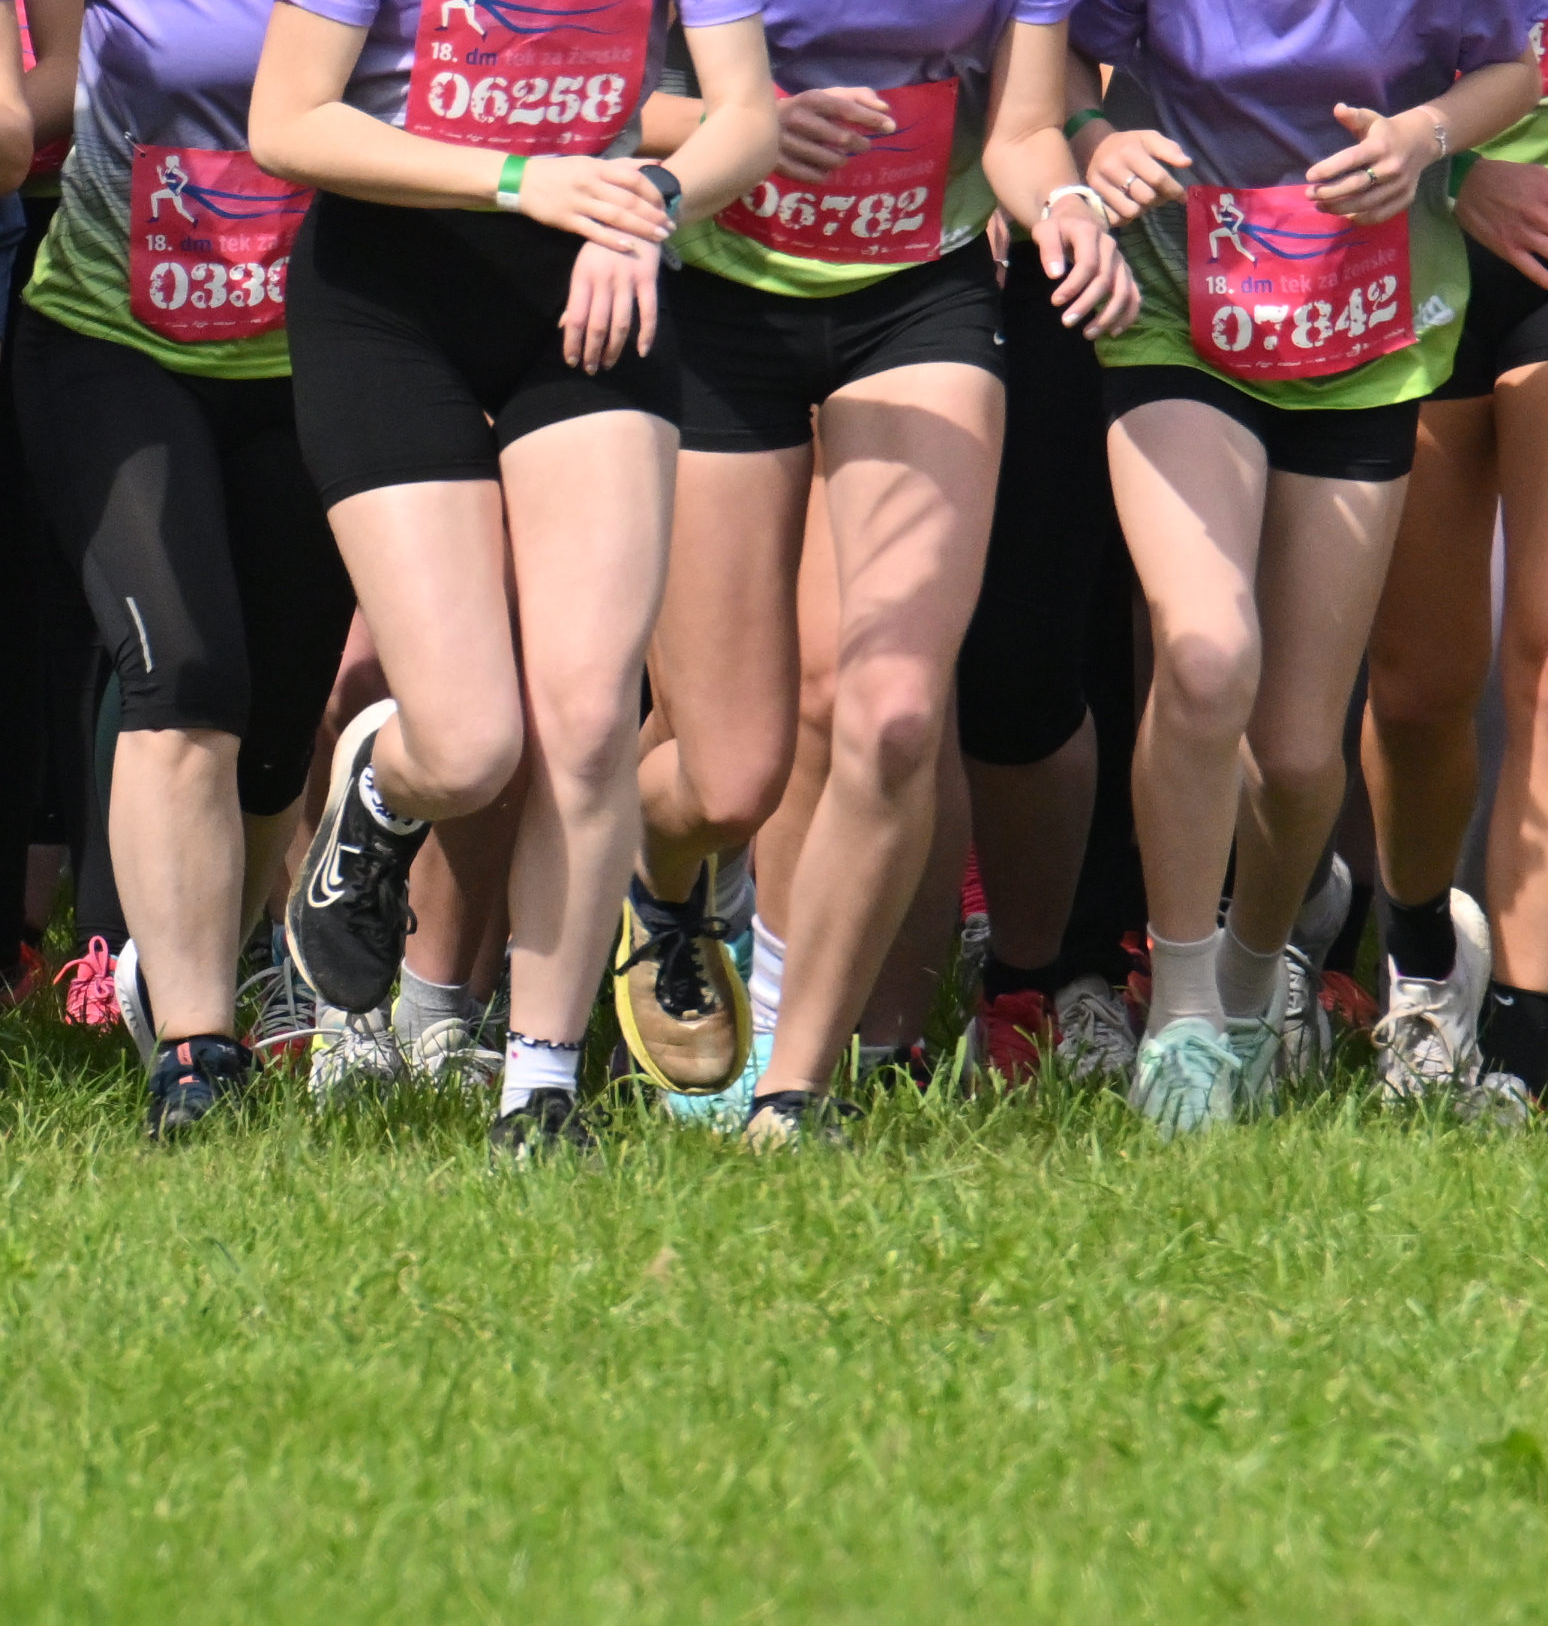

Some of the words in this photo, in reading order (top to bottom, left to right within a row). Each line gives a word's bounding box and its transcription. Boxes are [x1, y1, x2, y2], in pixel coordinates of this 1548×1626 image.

[431, 41, 458, 63] 18.
[466, 48, 497, 66] dm
[428, 72, 626, 125] 06258
[741, 181, 928, 238] 06782
[145, 234, 173, 251] 18.
[181, 235, 212, 252] dm
[219, 234, 251, 252] tek
[257, 236, 279, 251] za
[150, 256, 291, 310] 033
[1205, 275, 1235, 294] 18.
[1241, 276, 1273, 294] dm
[1280, 274, 1312, 293] tek
[1318, 272, 1338, 289] za
[1211, 275, 1397, 352] 07842
